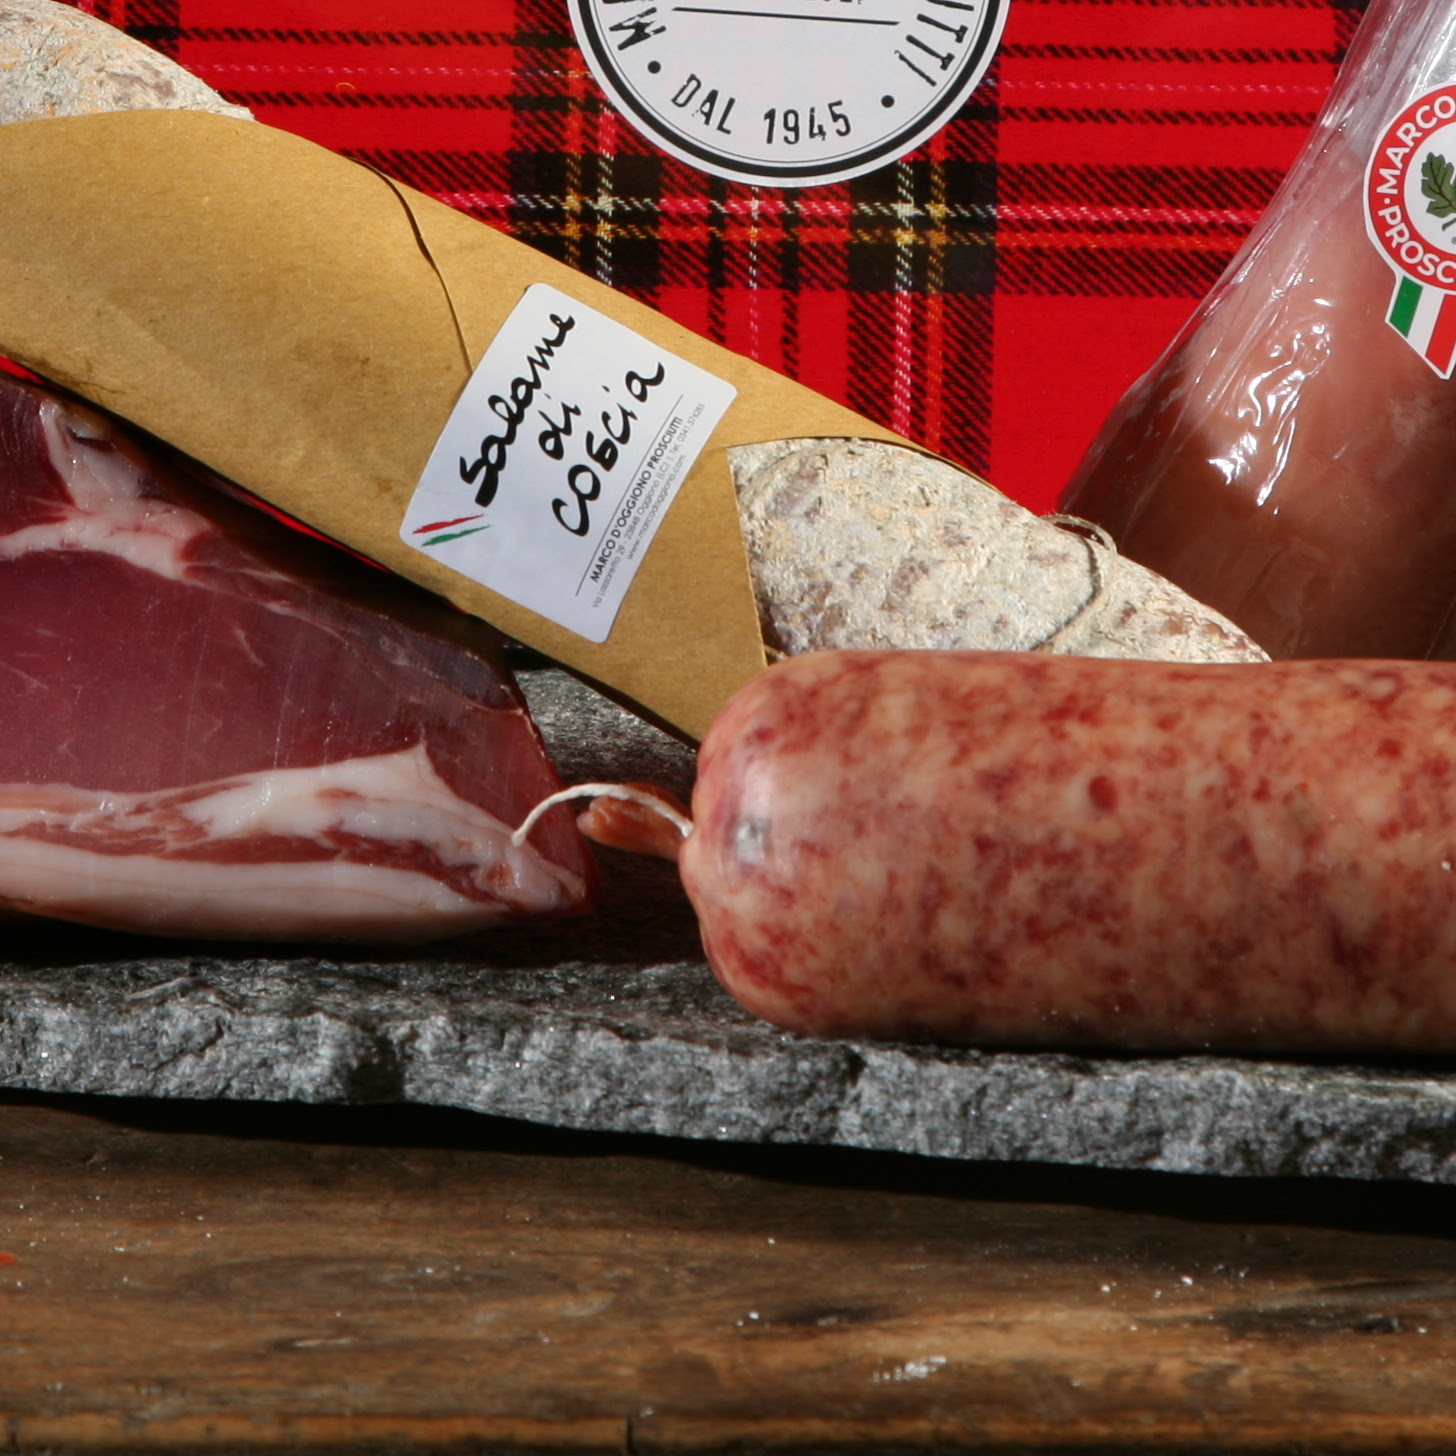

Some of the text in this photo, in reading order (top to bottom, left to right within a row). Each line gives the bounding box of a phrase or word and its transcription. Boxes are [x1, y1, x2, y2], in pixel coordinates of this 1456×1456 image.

[670, 73, 852, 145] DAL 1945
[1376, 95, 1456, 194] MARCO
[538, 392, 582, 461] di
[590, 416, 683, 583] MARCO D'OGGIONO PROSCIUTTI
[627, 454, 687, 560] www.marcodoggiono.com
[638, 480, 660, 516] Oggiono
